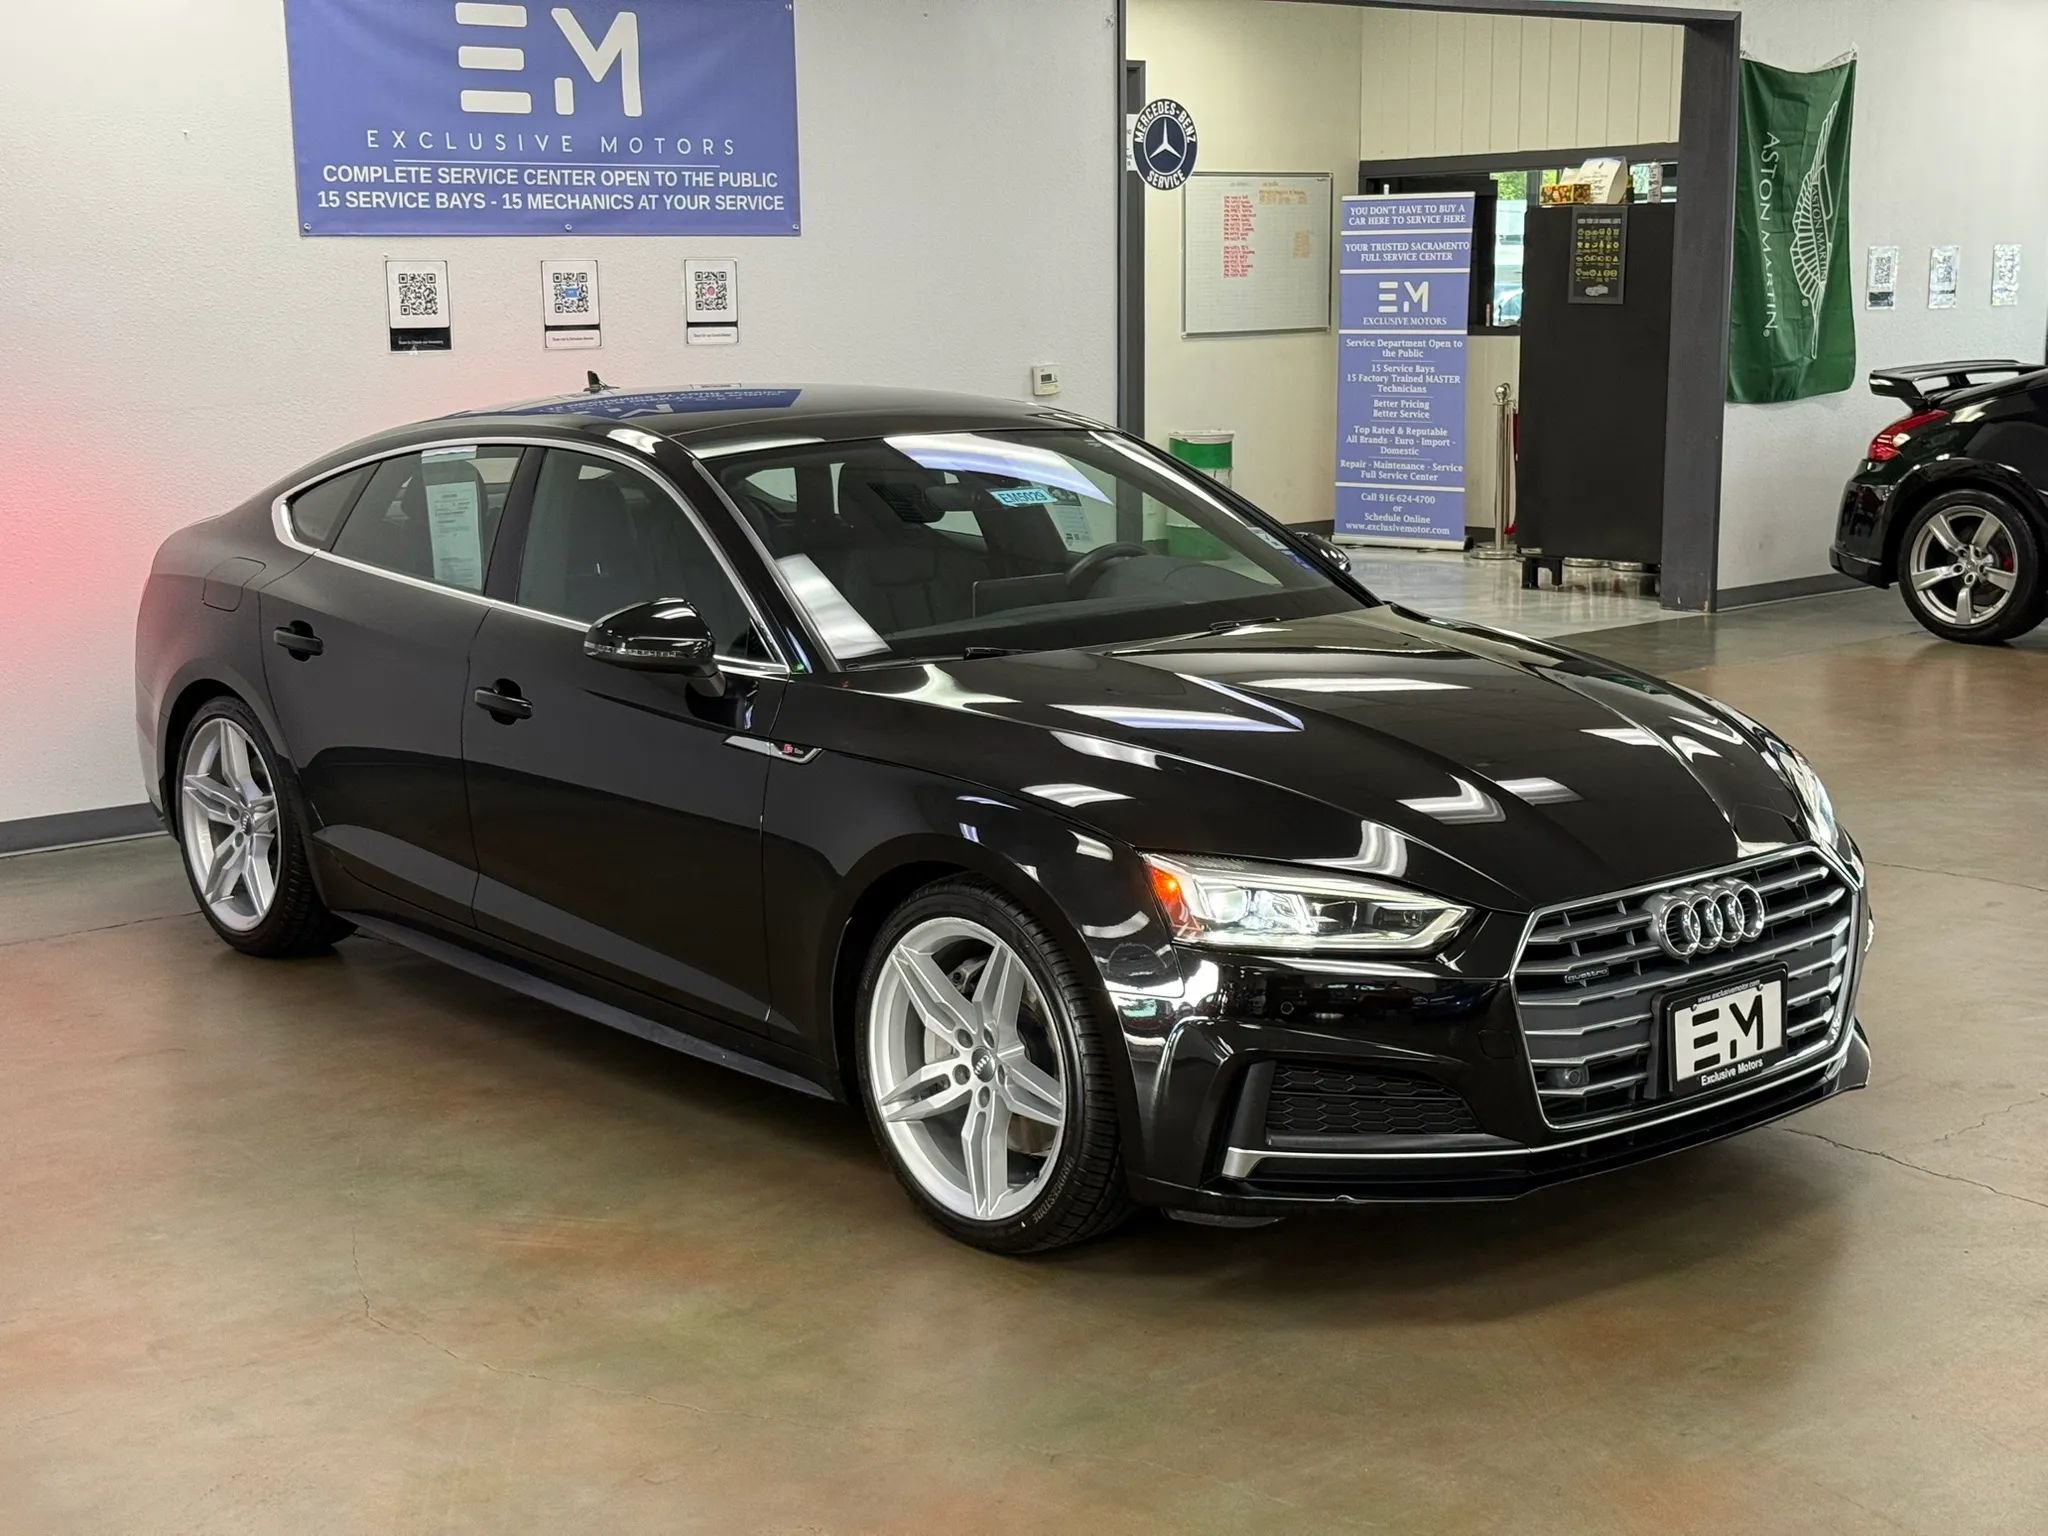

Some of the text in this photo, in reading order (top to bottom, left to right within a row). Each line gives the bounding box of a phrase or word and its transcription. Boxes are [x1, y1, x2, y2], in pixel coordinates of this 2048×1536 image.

[455, 3, 642, 117] EM
[367, 130, 734, 155] EXCLUSIVE MOTORS
[323, 165, 778, 188] COMPLETE SERVICE CENTER OPEN TO THE PUBLIC
[1146, 169, 1186, 189] SERVICE
[317, 191, 340, 208] 15
[345, 191, 429, 209] SERVICE
[436, 192, 486, 209] BAYS
[502, 192, 522, 210] 15
[528, 193, 634, 210] MECHANICS
[638, 194, 659, 210] AT
[663, 194, 710, 211] YOUR
[715, 195, 785, 211] SERVICE
[1350, 204, 1465, 215] YOU DON'T HAVE TO BUY A
[1349, 214, 1466, 226] CAR HERE TO SERVICE HERE
[1758, 131, 1781, 330] ASTON MARTIN
[1811, 184, 1827, 282] ASTON MARTIN
[1345, 241, 1469, 252] YOUR TRUSTED SACRAMENTO
[1361, 252, 1453, 262] FULL SERVICE CENTER
[1378, 281, 1429, 313] EM
[1363, 317, 1447, 325] EXCLUSIVE MOTORS
[1346, 339, 1375, 347] Service
[1377, 339, 1426, 349] Department
[1429, 340, 1452, 349] Open
[1382, 349, 1423, 358] the Public
[1372, 364, 1435, 375] 15 Service Bays
[1347, 374, 1460, 384] 15 Factory Trained MASTER
[1377, 385, 1427, 393] Technicians
[1373, 400, 1430, 410] Better Pricing
[1373, 409, 1430, 419] Better Service
[1354, 425, 1448, 437] Top Rated & Reputable
[1346, 435, 1357, 443] All
[1360, 435, 1387, 444] Brands
[1395, 437, 1414, 445] Euro
[1421, 438, 1450, 447] Import
[1380, 447, 1419, 455] Domestic
[1340, 460, 1366, 469] Repair
[1373, 461, 1425, 470] Maintenance
[1433, 463, 1463, 472] Service
[1361, 471, 1438, 481] Full Service Center
[1361, 493, 1435, 504] Call 916-624-4700
[1365, 513, 1431, 523] Schedule Online
[1346, 522, 1450, 535] www.exclusivemotor.com
[1692, 994, 1764, 1072] EM
[1700, 1058, 1764, 1087] Exclusive Motors
